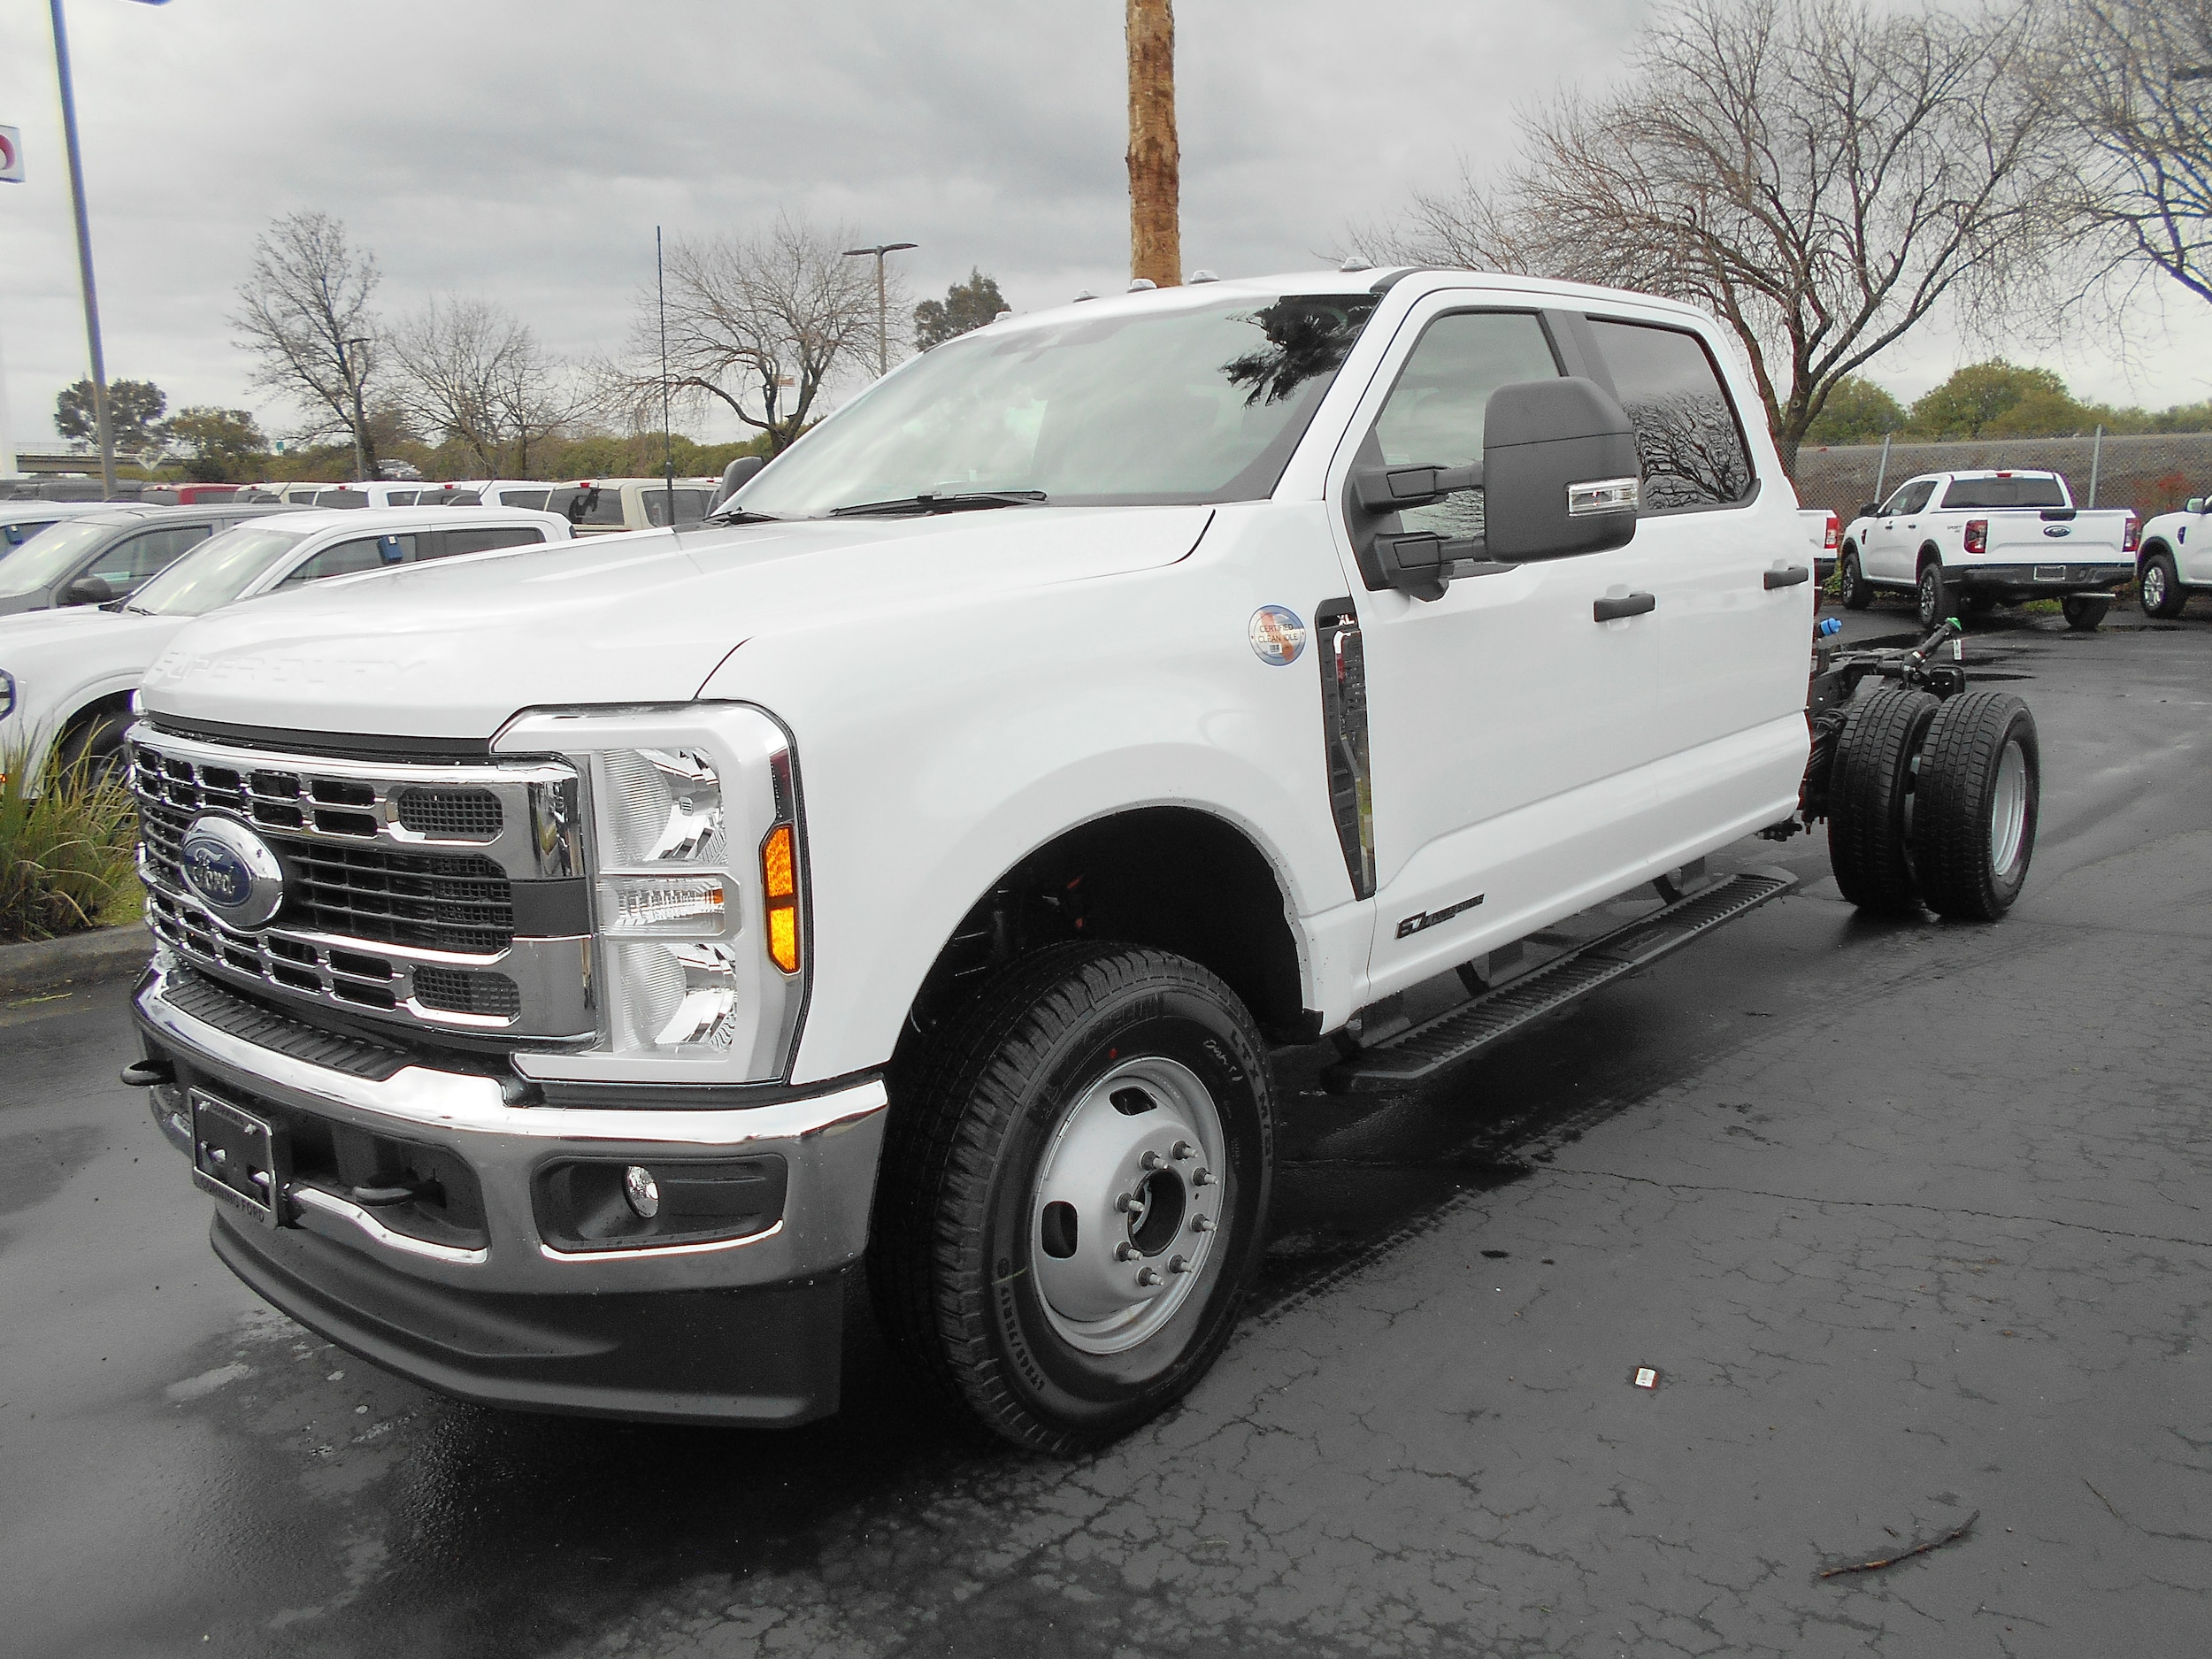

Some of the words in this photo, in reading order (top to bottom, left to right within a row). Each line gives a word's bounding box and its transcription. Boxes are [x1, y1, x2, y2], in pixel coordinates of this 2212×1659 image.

[1336, 613, 1356, 626] XL
[1259, 623, 1294, 634] CERTIFIED
[1257, 634, 1281, 643] CLEAN
[1230, 1029, 1260, 1082] LTX
[241, 1199, 265, 1223] FORD
